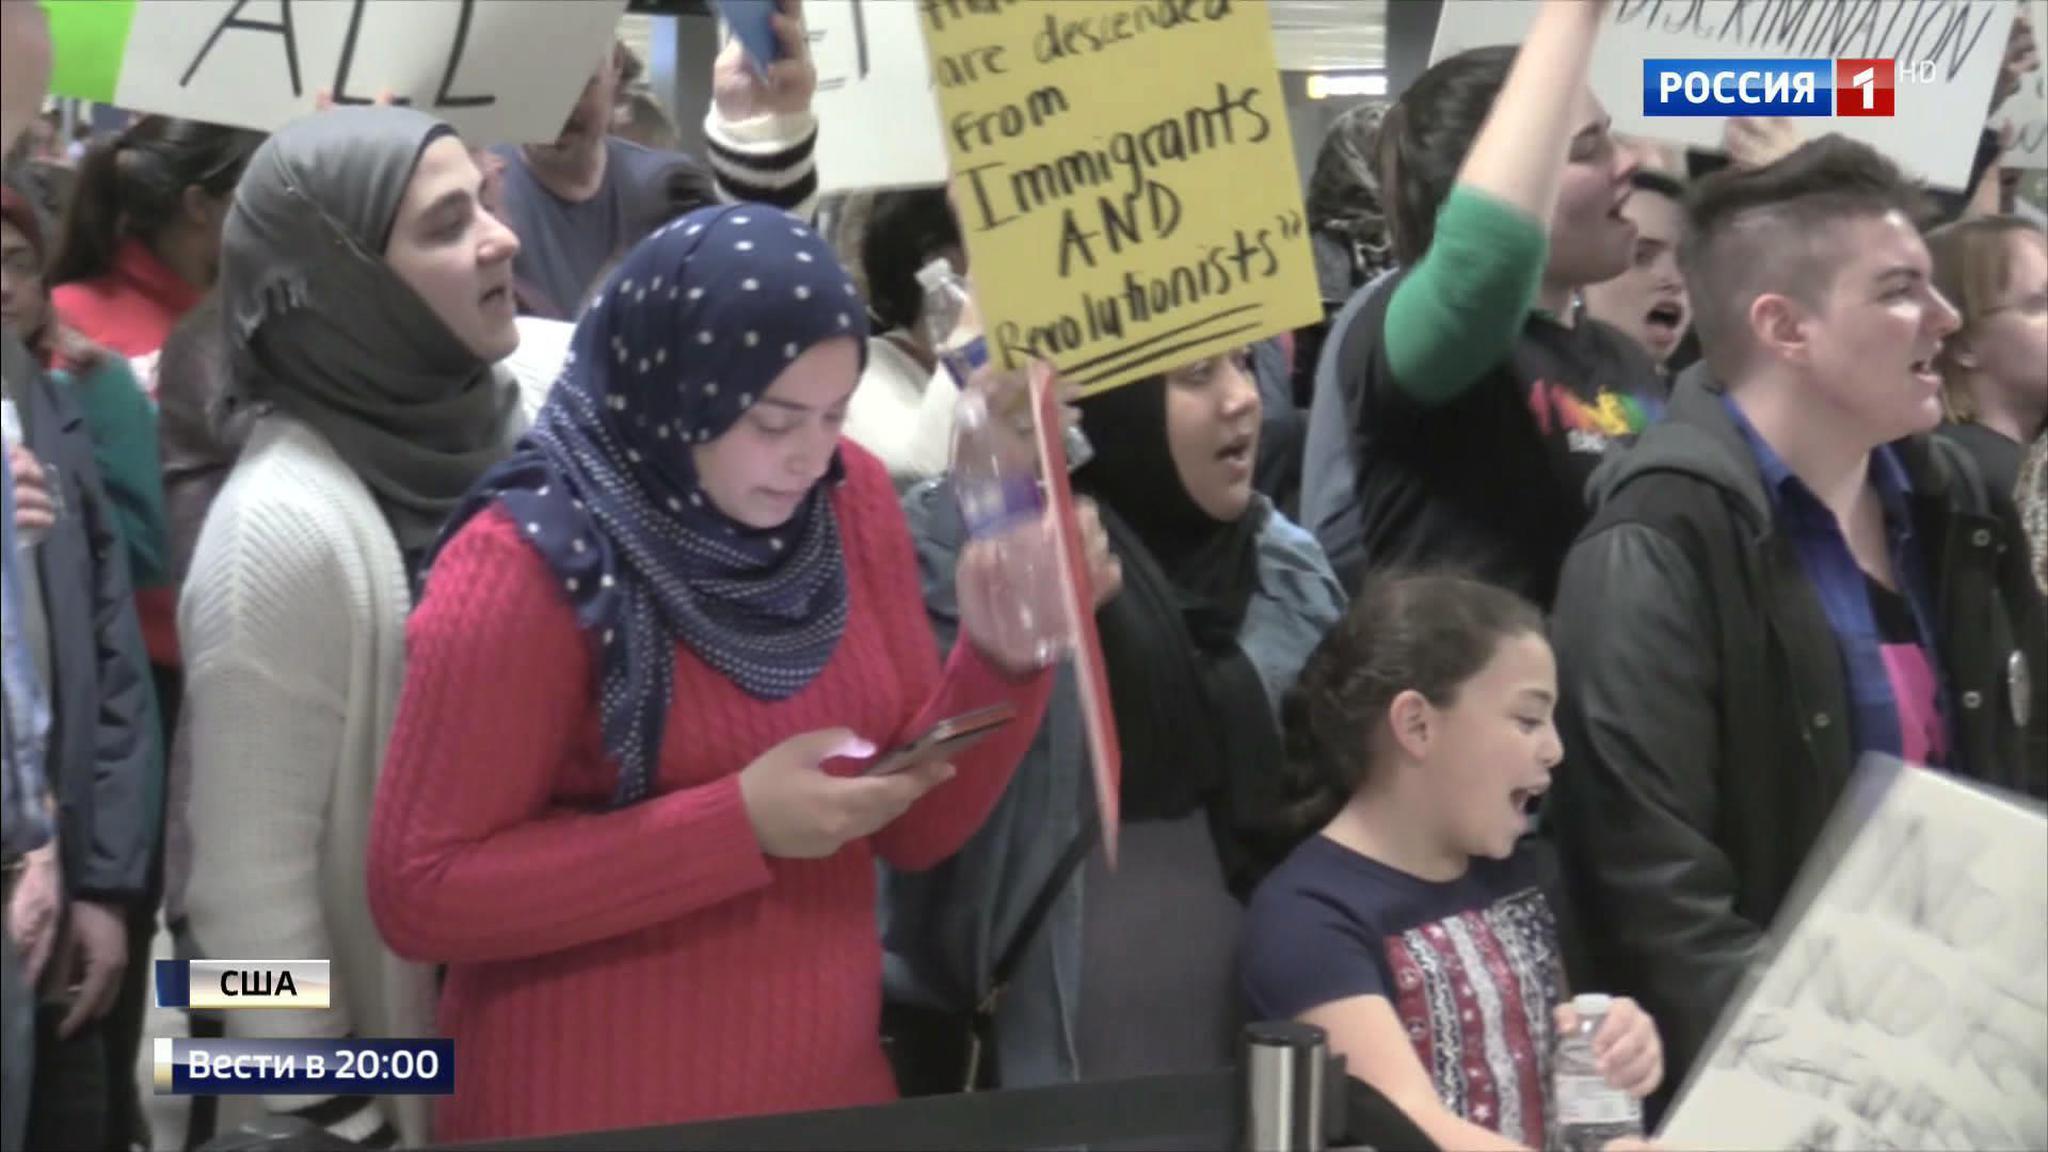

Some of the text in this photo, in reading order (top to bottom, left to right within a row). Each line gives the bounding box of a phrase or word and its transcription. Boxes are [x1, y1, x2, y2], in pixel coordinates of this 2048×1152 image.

[178, 0, 497, 107] ALL
[936, 46, 1007, 88] are
[954, 82, 1271, 234] Immigrants
[1058, 180, 1182, 278] AND
